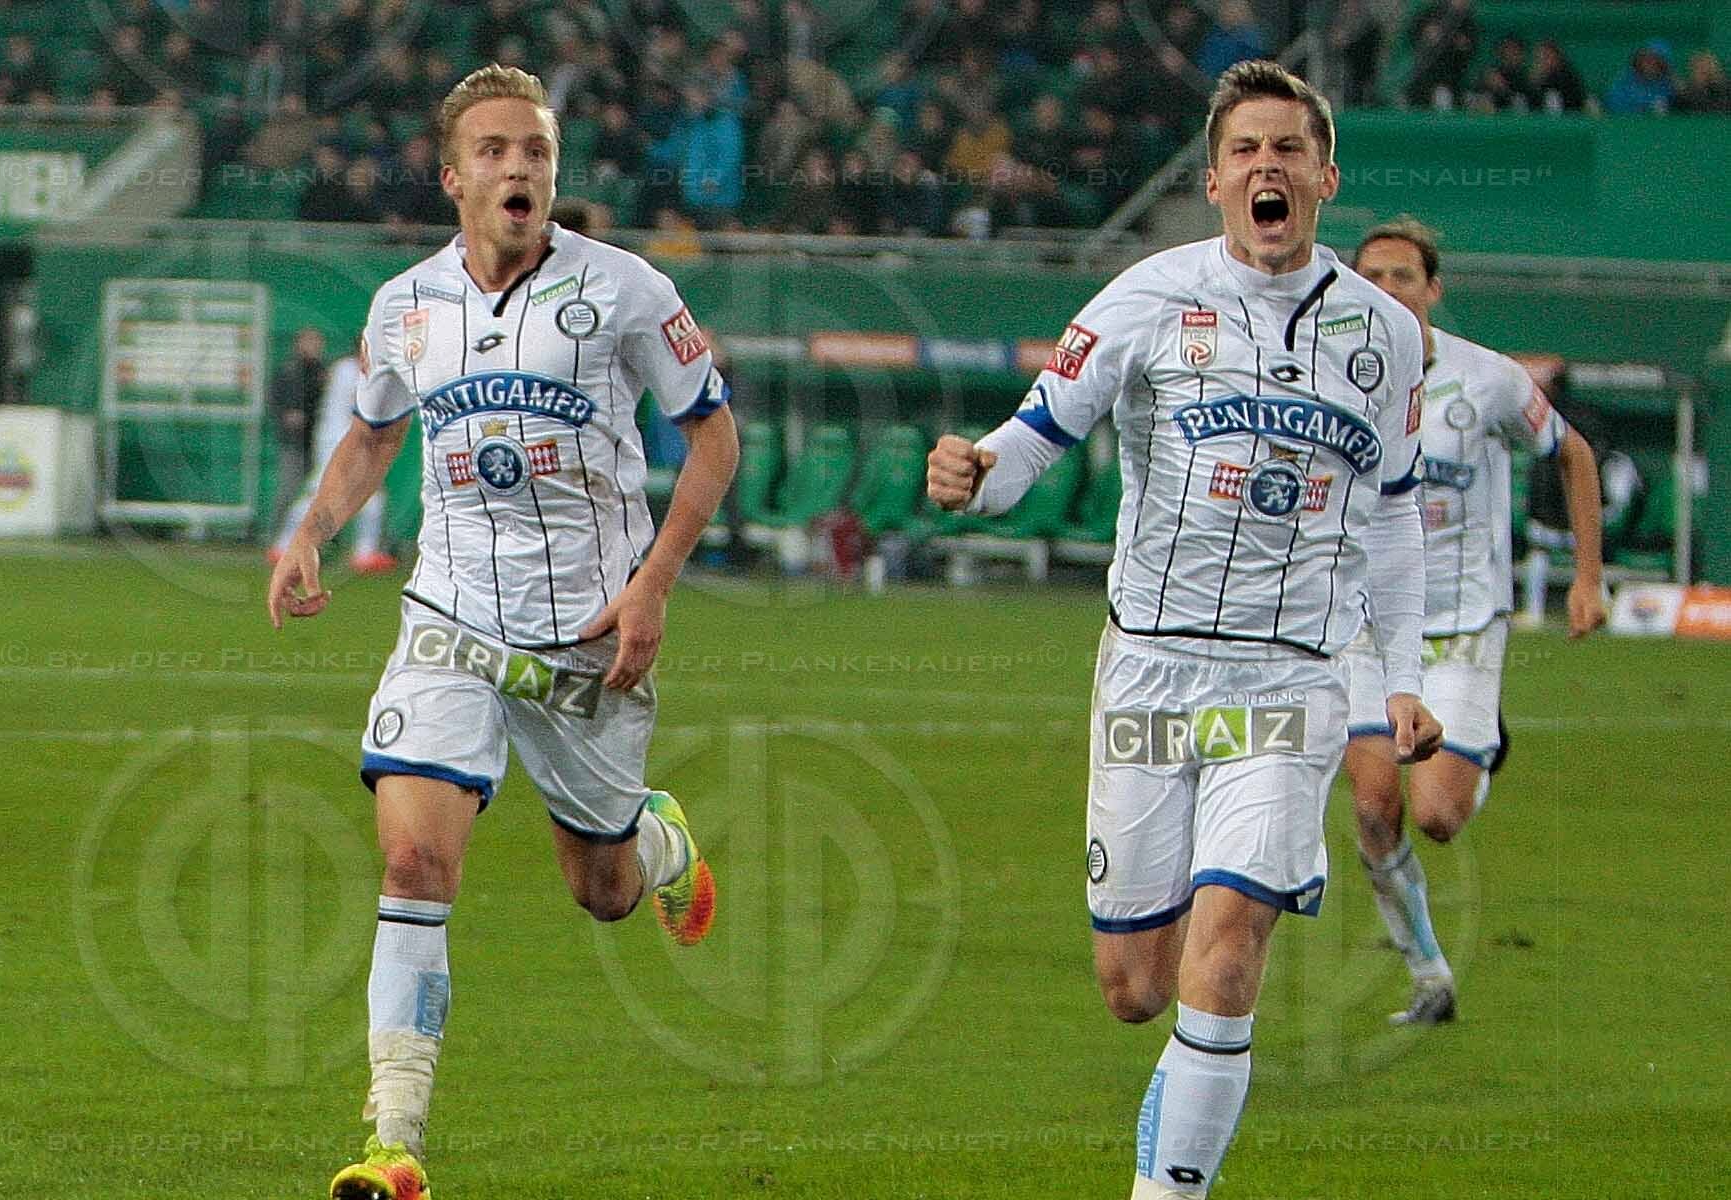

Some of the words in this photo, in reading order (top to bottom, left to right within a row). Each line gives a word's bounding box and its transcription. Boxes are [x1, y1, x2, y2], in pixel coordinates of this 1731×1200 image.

[1183, 406, 1380, 468] PUNTIGAMER
[412, 628, 594, 713] GRAZ
[1108, 711, 1295, 761] GRAZ
